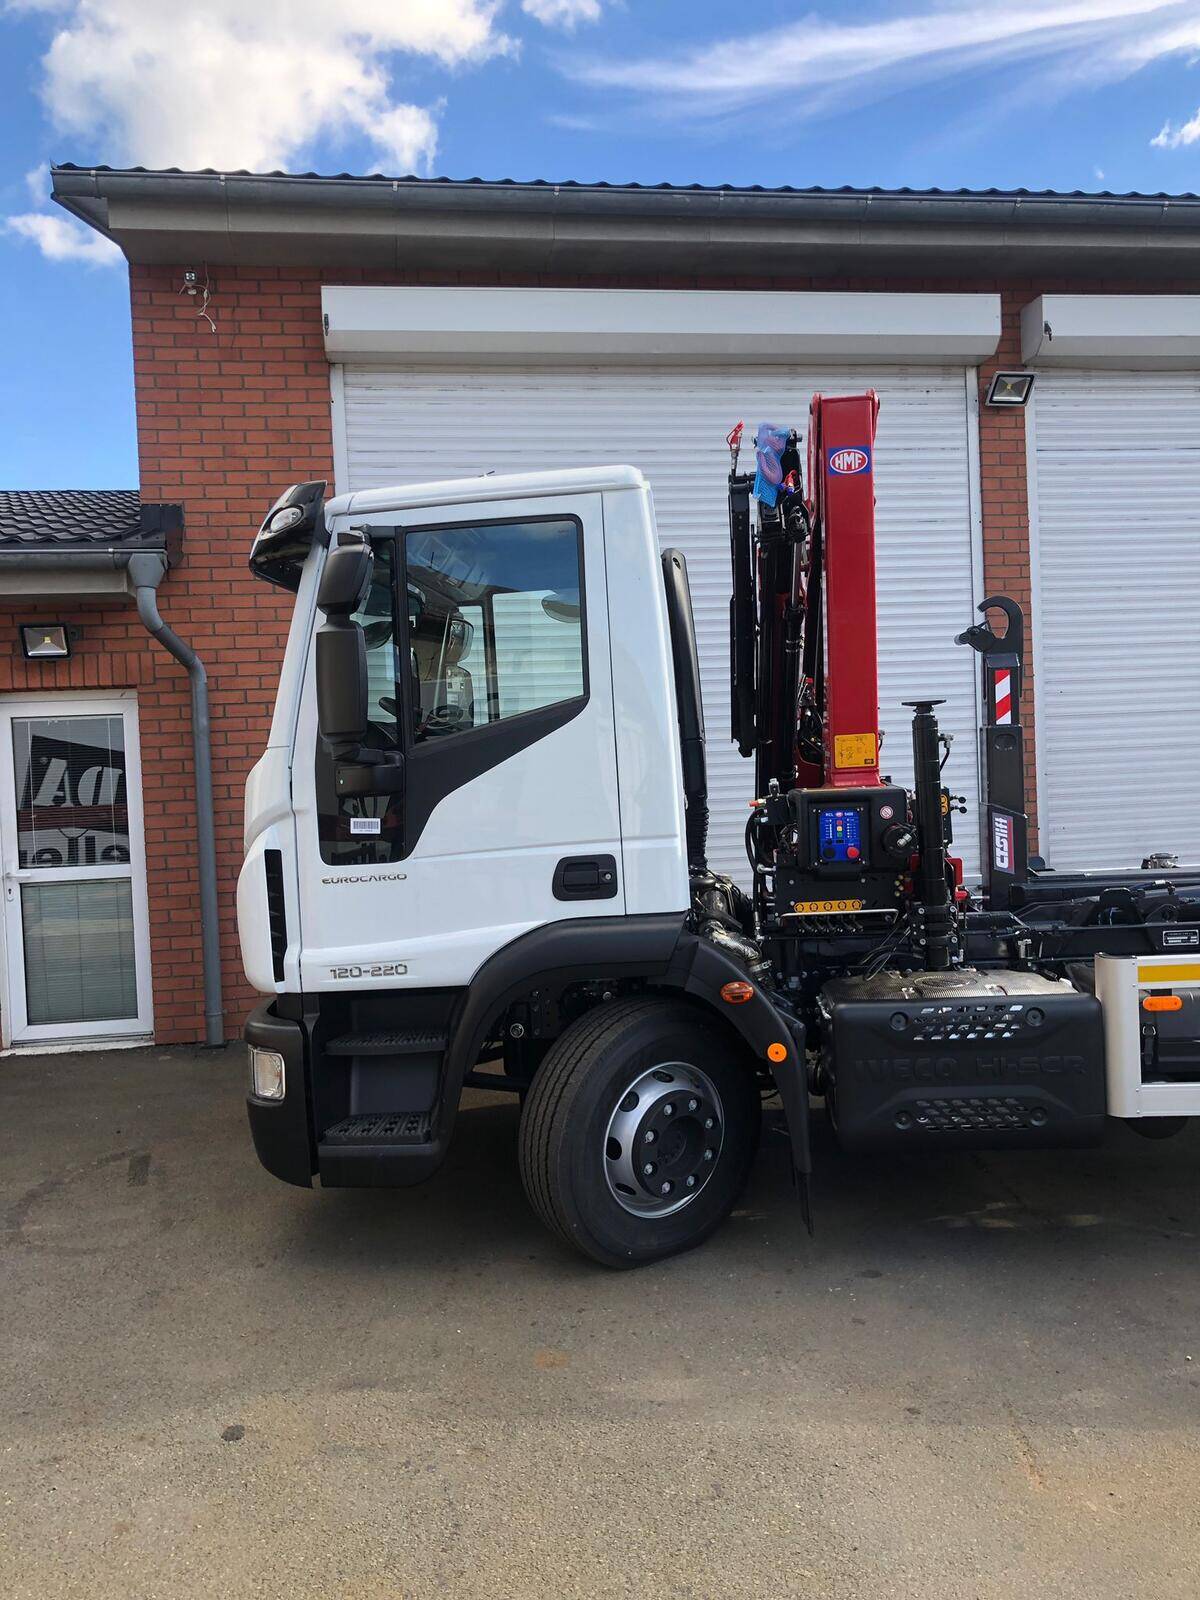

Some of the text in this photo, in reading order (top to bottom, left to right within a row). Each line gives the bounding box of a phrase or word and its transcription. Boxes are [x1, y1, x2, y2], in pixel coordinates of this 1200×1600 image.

[834, 452, 863, 470] HMF
[322, 873, 407, 885] EUROCARGO
[330, 963, 408, 980] 120-220
[855, 1057, 958, 1081] IVECO
